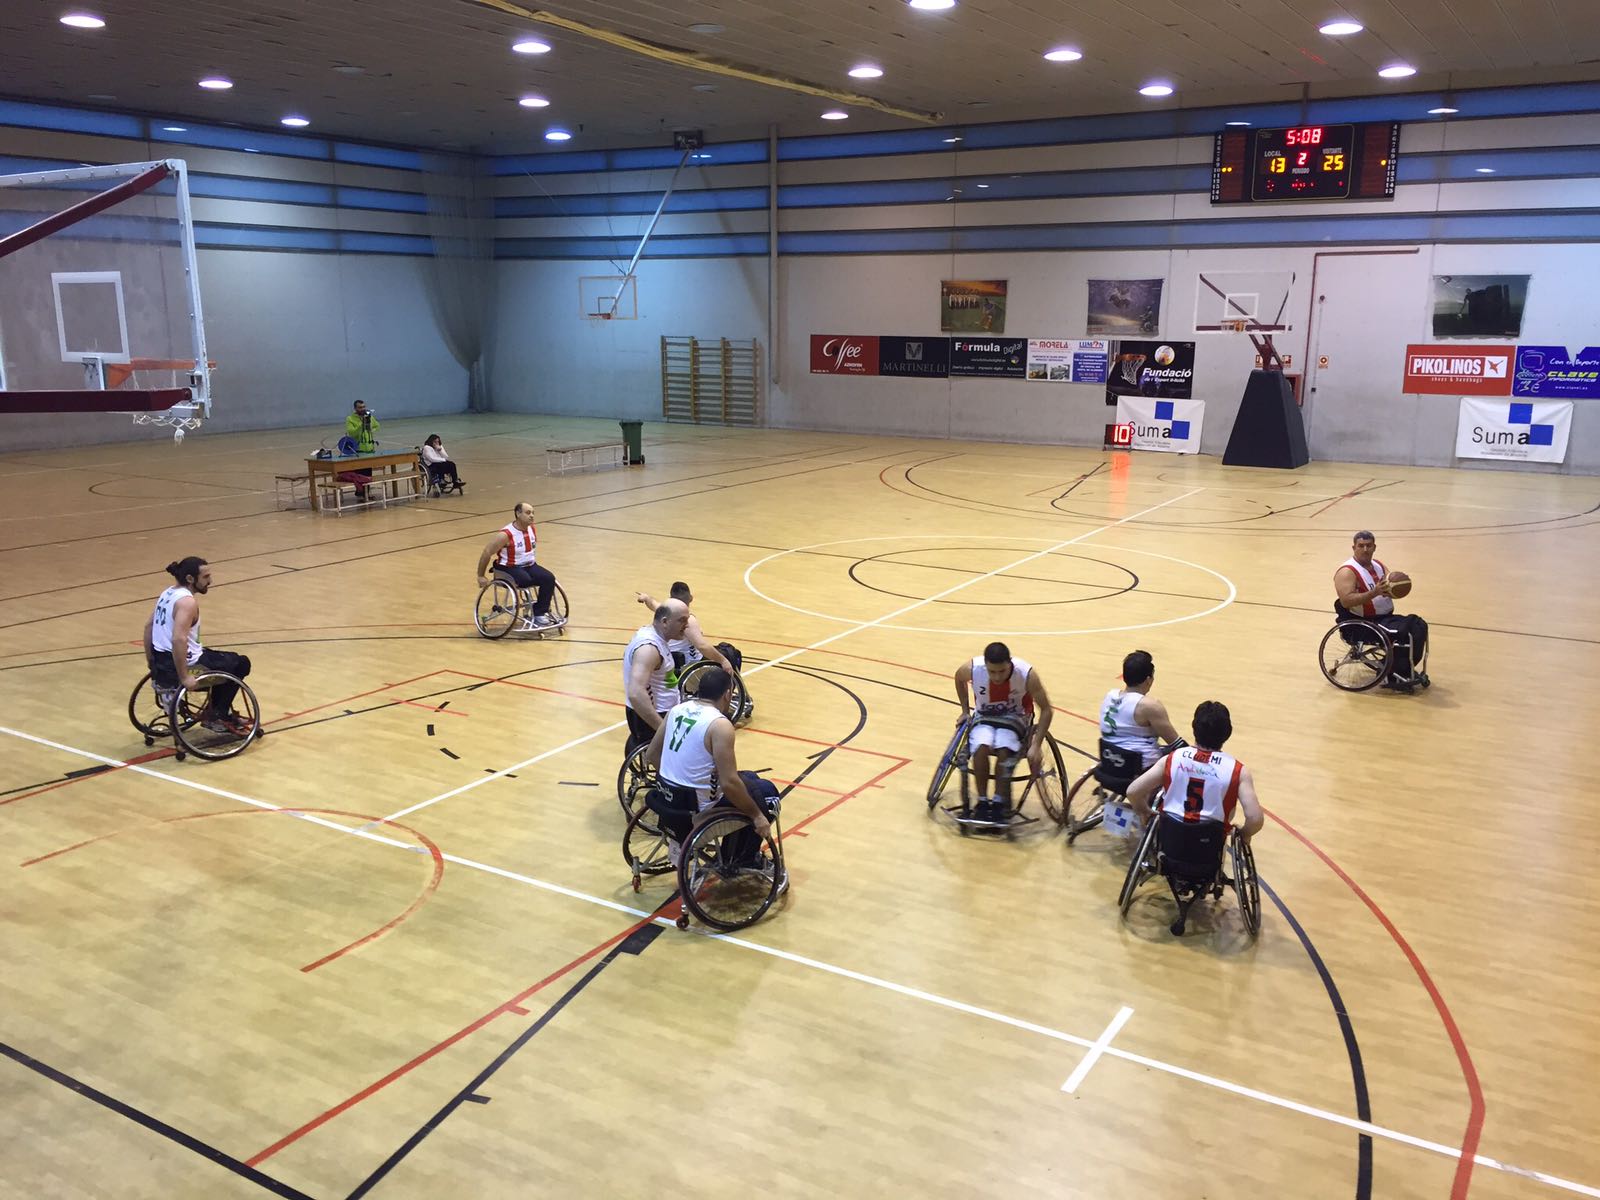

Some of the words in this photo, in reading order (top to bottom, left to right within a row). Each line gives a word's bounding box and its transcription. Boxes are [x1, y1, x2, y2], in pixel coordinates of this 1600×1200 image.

[1286, 128, 1322, 145] 5:08
[1264, 150, 1281, 158] LOCAL
[1270, 157, 1286, 173] 13
[1298, 152, 1307, 165] 2
[1323, 154, 1344, 171] 25
[1003, 341, 1023, 355] Digital
[1039, 341, 1068, 349] MORELA
[883, 362, 946, 373] MARTINELLI
[1142, 367, 1192, 378] Fundació
[1413, 358, 1482, 375] PIKOLINOS
[1113, 425, 1131, 443] 10
[1128, 421, 1172, 439] Suma
[1472, 426, 1530, 445] Suma
[1103, 706, 1118, 736] 5
[669, 715, 698, 752] 17
[1184, 781, 1204, 813] 5
